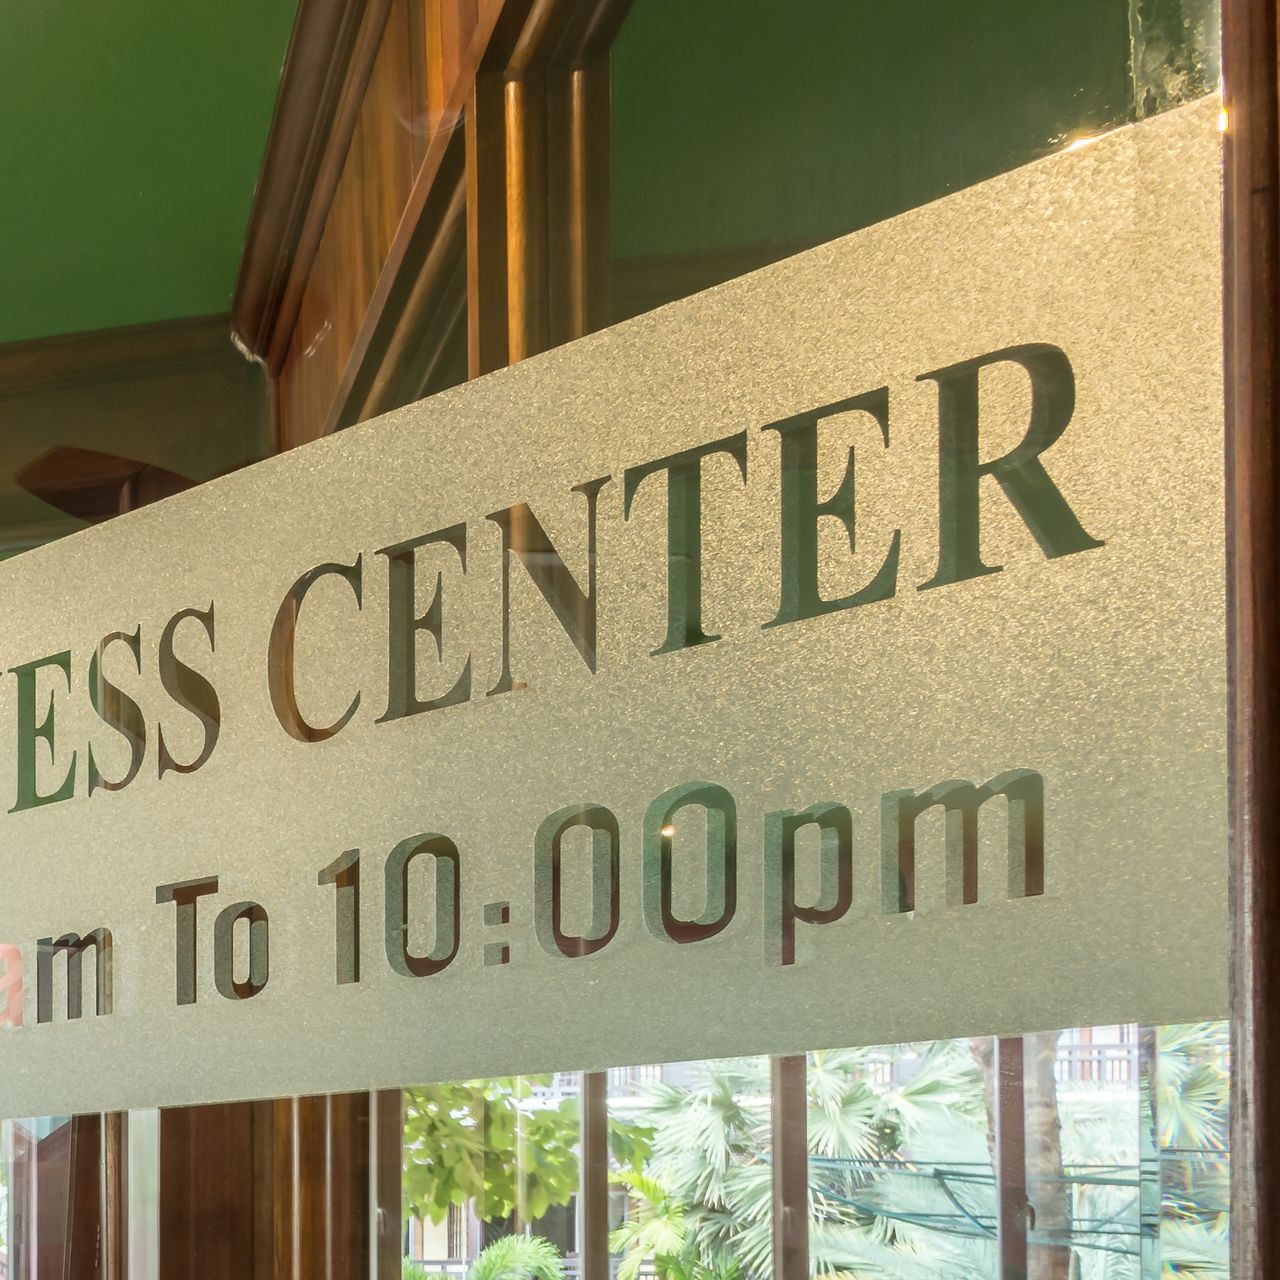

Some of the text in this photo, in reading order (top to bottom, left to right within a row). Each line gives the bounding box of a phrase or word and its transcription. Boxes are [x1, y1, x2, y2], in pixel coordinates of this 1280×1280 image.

[267, 341, 1106, 744] CENTER
[155, 874, 270, 1007] To
[317, 767, 1045, 985] 10:00pm
